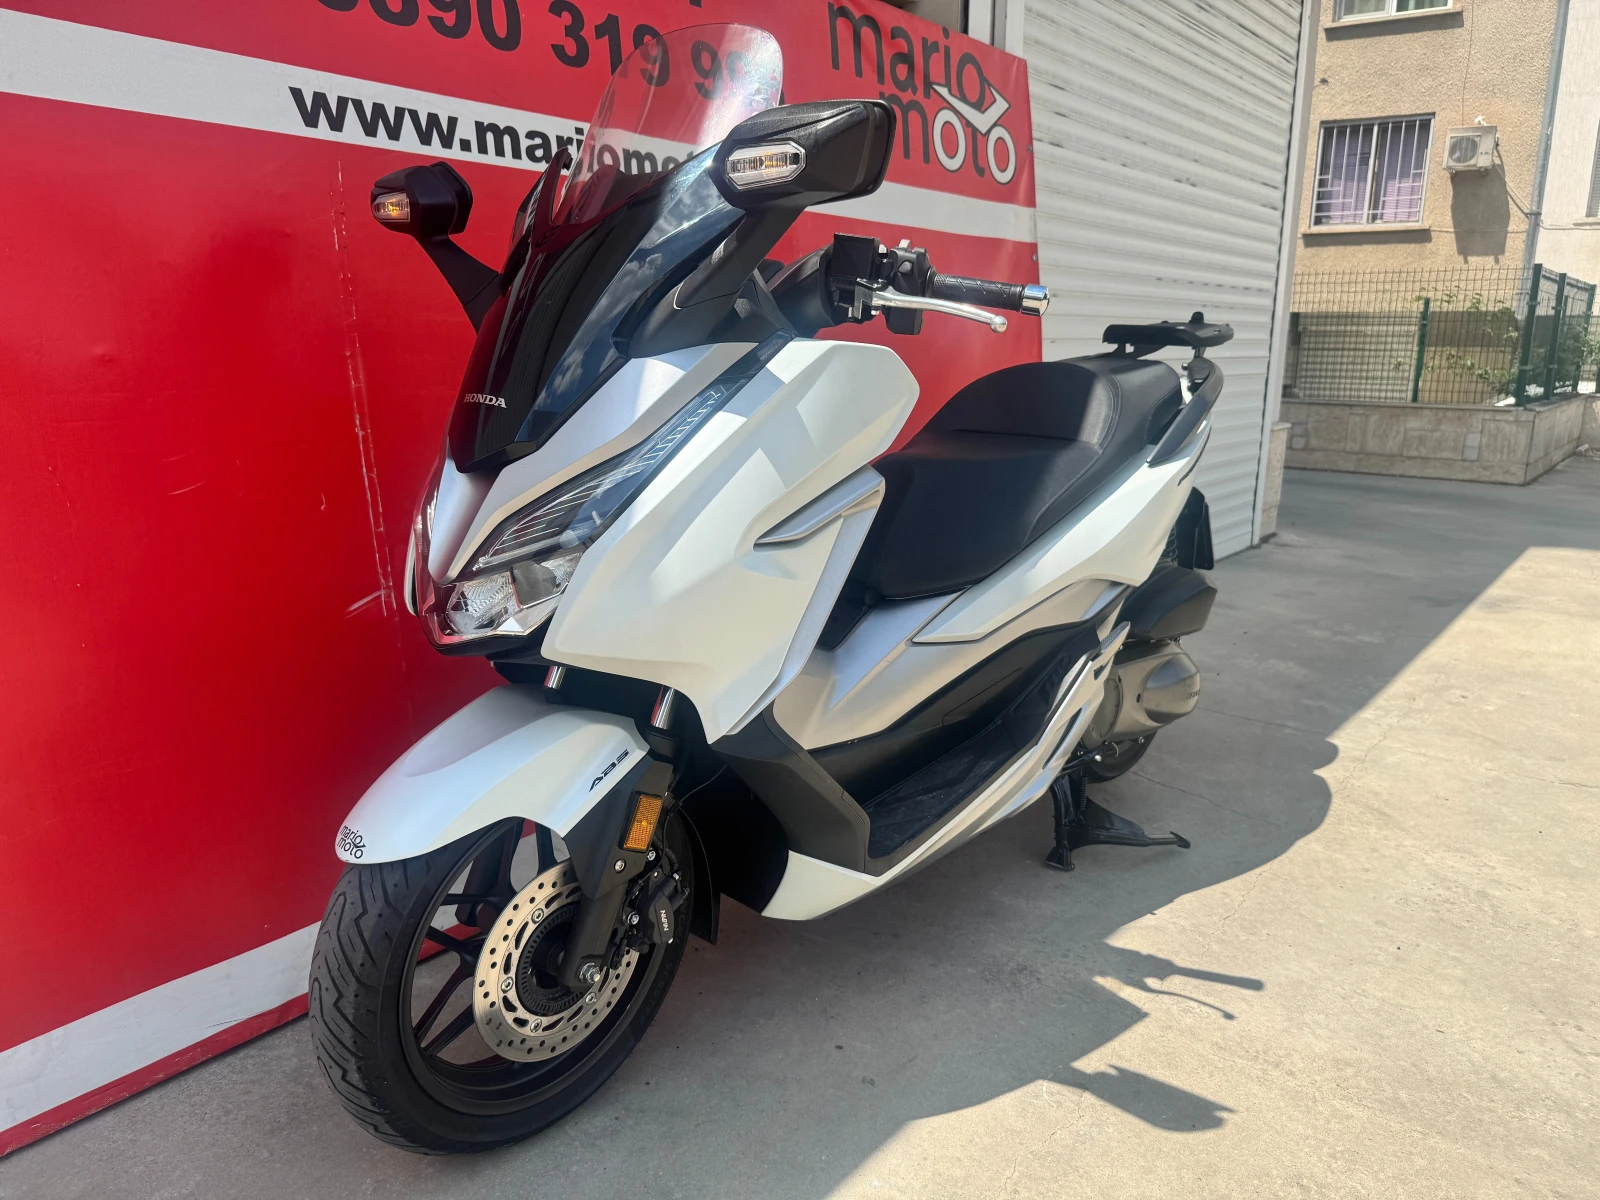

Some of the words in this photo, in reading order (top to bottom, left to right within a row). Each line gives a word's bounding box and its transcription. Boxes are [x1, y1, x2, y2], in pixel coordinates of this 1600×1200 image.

[547, 0, 670, 88] 319
[827, 2, 986, 112] mario
[879, 90, 1017, 186] moto
[463, 393, 507, 409] HONDA
[588, 748, 629, 792] ABS
[336, 837, 364, 859] moto
[340, 825, 363, 846] mario
